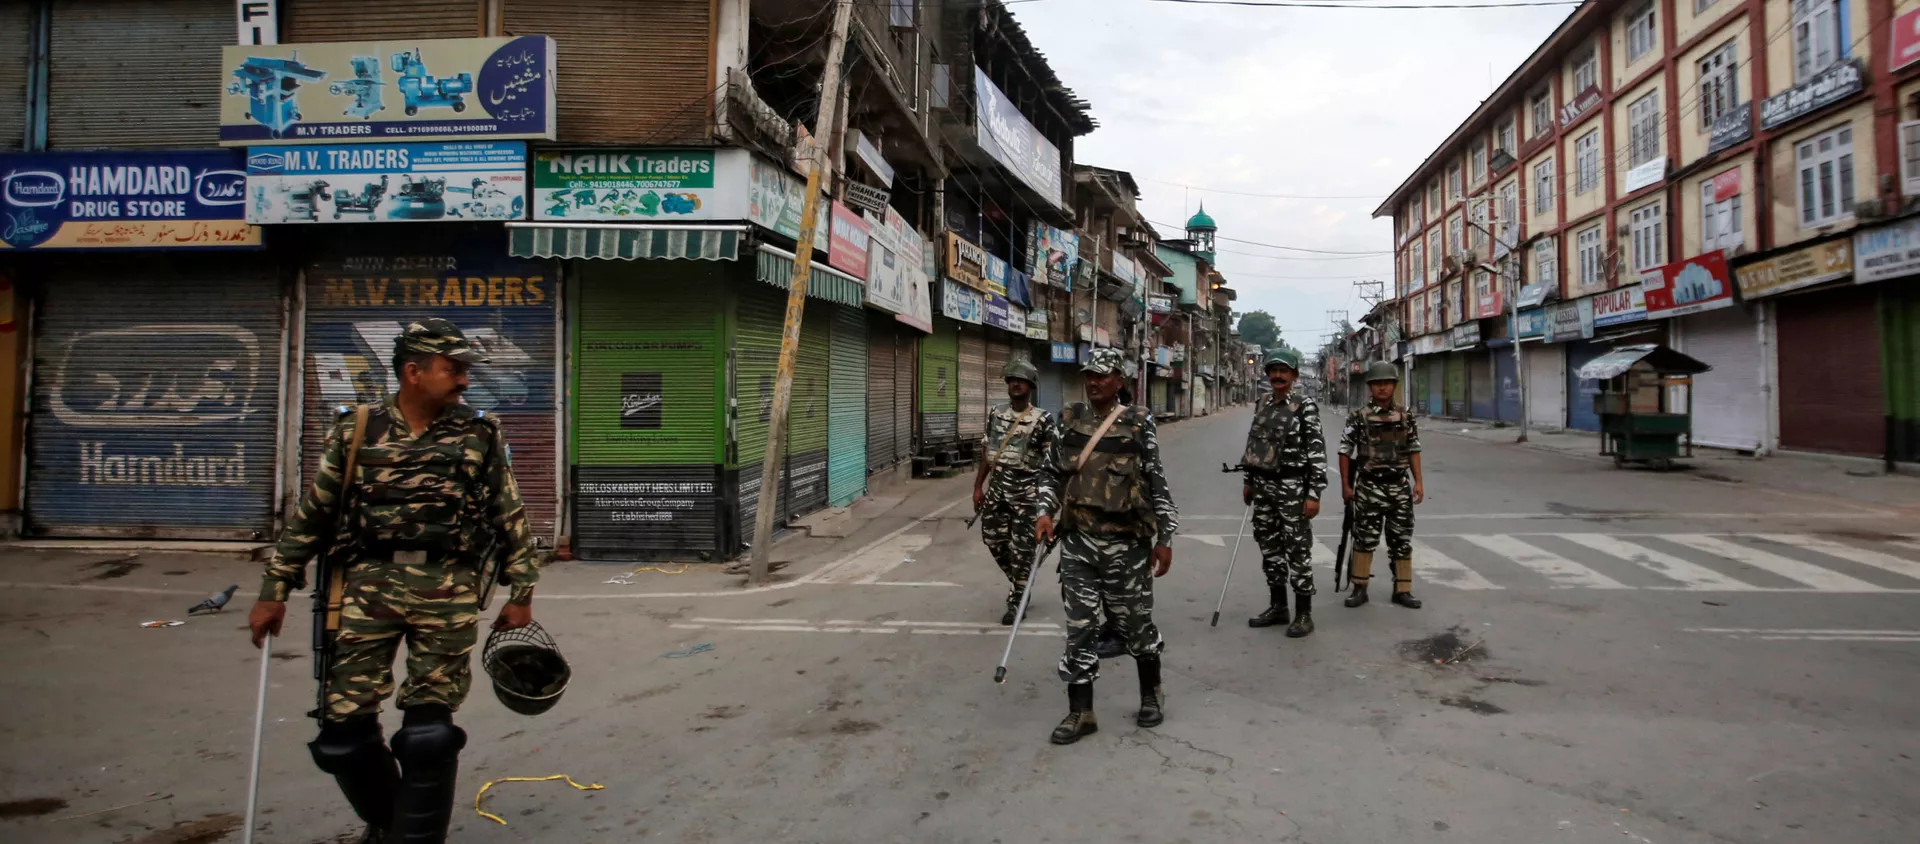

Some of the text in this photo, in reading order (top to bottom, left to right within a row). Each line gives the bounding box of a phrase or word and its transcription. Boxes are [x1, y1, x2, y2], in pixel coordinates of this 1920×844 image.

[321, 125, 371, 135] TRADERS
[284, 149, 409, 171] M.V. TRADERS
[551, 154, 632, 175] NAIK
[635, 156, 711, 174] Traders
[15, 181, 59, 195] Hamdard
[70, 166, 190, 195] HAMDARD
[847, 191, 885, 209] ENTERPRISES
[850, 183, 887, 202] SHAHKAR
[72, 200, 186, 217] DRUG STORE
[1593, 290, 1631, 316] POPULAR
[79, 441, 248, 486] Hamdard
